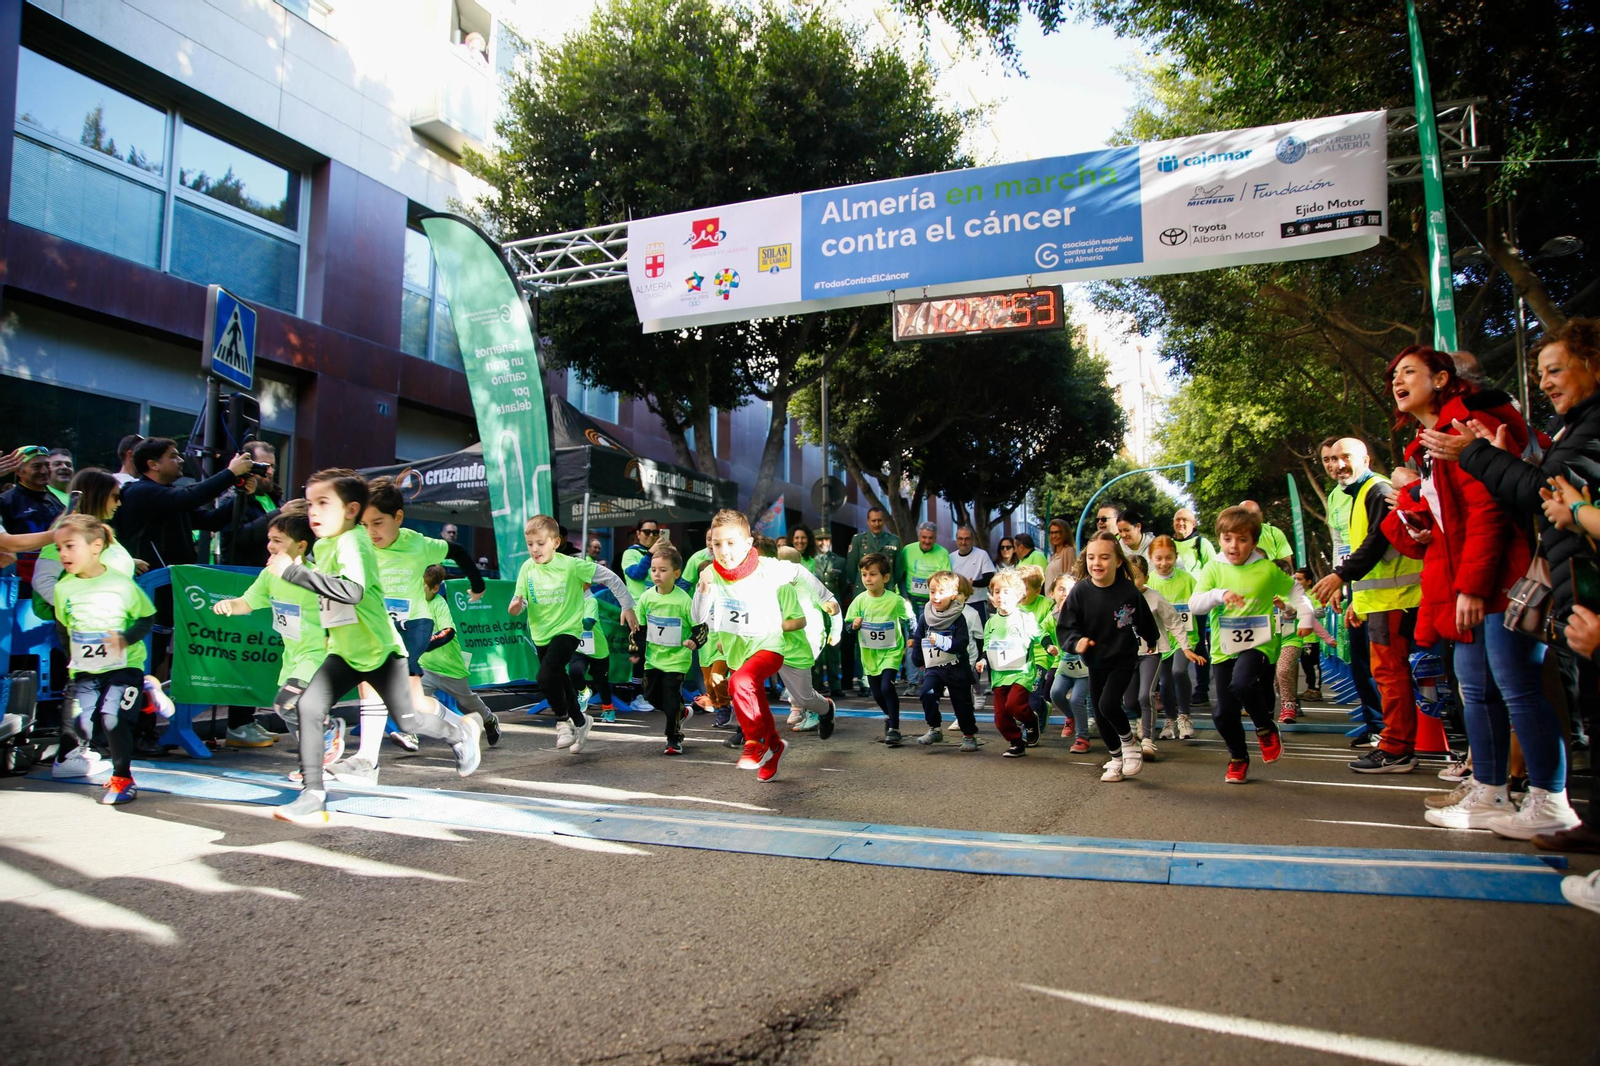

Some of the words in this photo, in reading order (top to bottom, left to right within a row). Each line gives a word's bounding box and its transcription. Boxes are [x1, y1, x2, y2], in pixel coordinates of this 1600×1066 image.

[1307, 133, 1370, 146] UNIVERSIDAD
[1183, 149, 1253, 167] cajamar
[1307, 147, 1321, 155] DE
[821, 187, 936, 225] Almería
[946, 183, 983, 205] en
[995, 165, 1118, 199] marcha
[1253, 179, 1335, 199] Fundación
[1187, 197, 1235, 207] MICHELIN
[1296, 202, 1324, 217] Ejido
[1328, 199, 1365, 210] Motor
[821, 227, 917, 257] contra
[926, 216, 956, 243] el
[964, 206, 1076, 238] cáncer
[1192, 223, 1227, 233] Toyota
[1062, 239, 1100, 249] asociación
[1101, 235, 1133, 246] española
[1193, 233, 1231, 244] Alborán
[1235, 230, 1265, 240] Motor
[1064, 248, 1086, 257] contra
[1087, 246, 1094, 254] el
[1095, 244, 1119, 253] cáncer
[814, 271, 910, 290] #TodosContraElCáncer
[425, 462, 486, 486] cruzando
[729, 610, 749, 624] 21
[1181, 613, 1188, 622] 9
[188, 622, 242, 644] Contra
[246, 631, 263, 647] el
[460, 621, 492, 635] Contra
[492, 620, 502, 633] el
[657, 626, 665, 636] 7
[465, 637, 494, 648] somos
[870, 631, 886, 640] 95
[1232, 629, 1255, 642] 32
[82, 645, 107, 659] 24
[188, 642, 237, 661] somos
[241, 648, 278, 663] solo
[928, 648, 940, 658] 17
[1066, 660, 1083, 670] 31
[120, 686, 139, 711] 9
